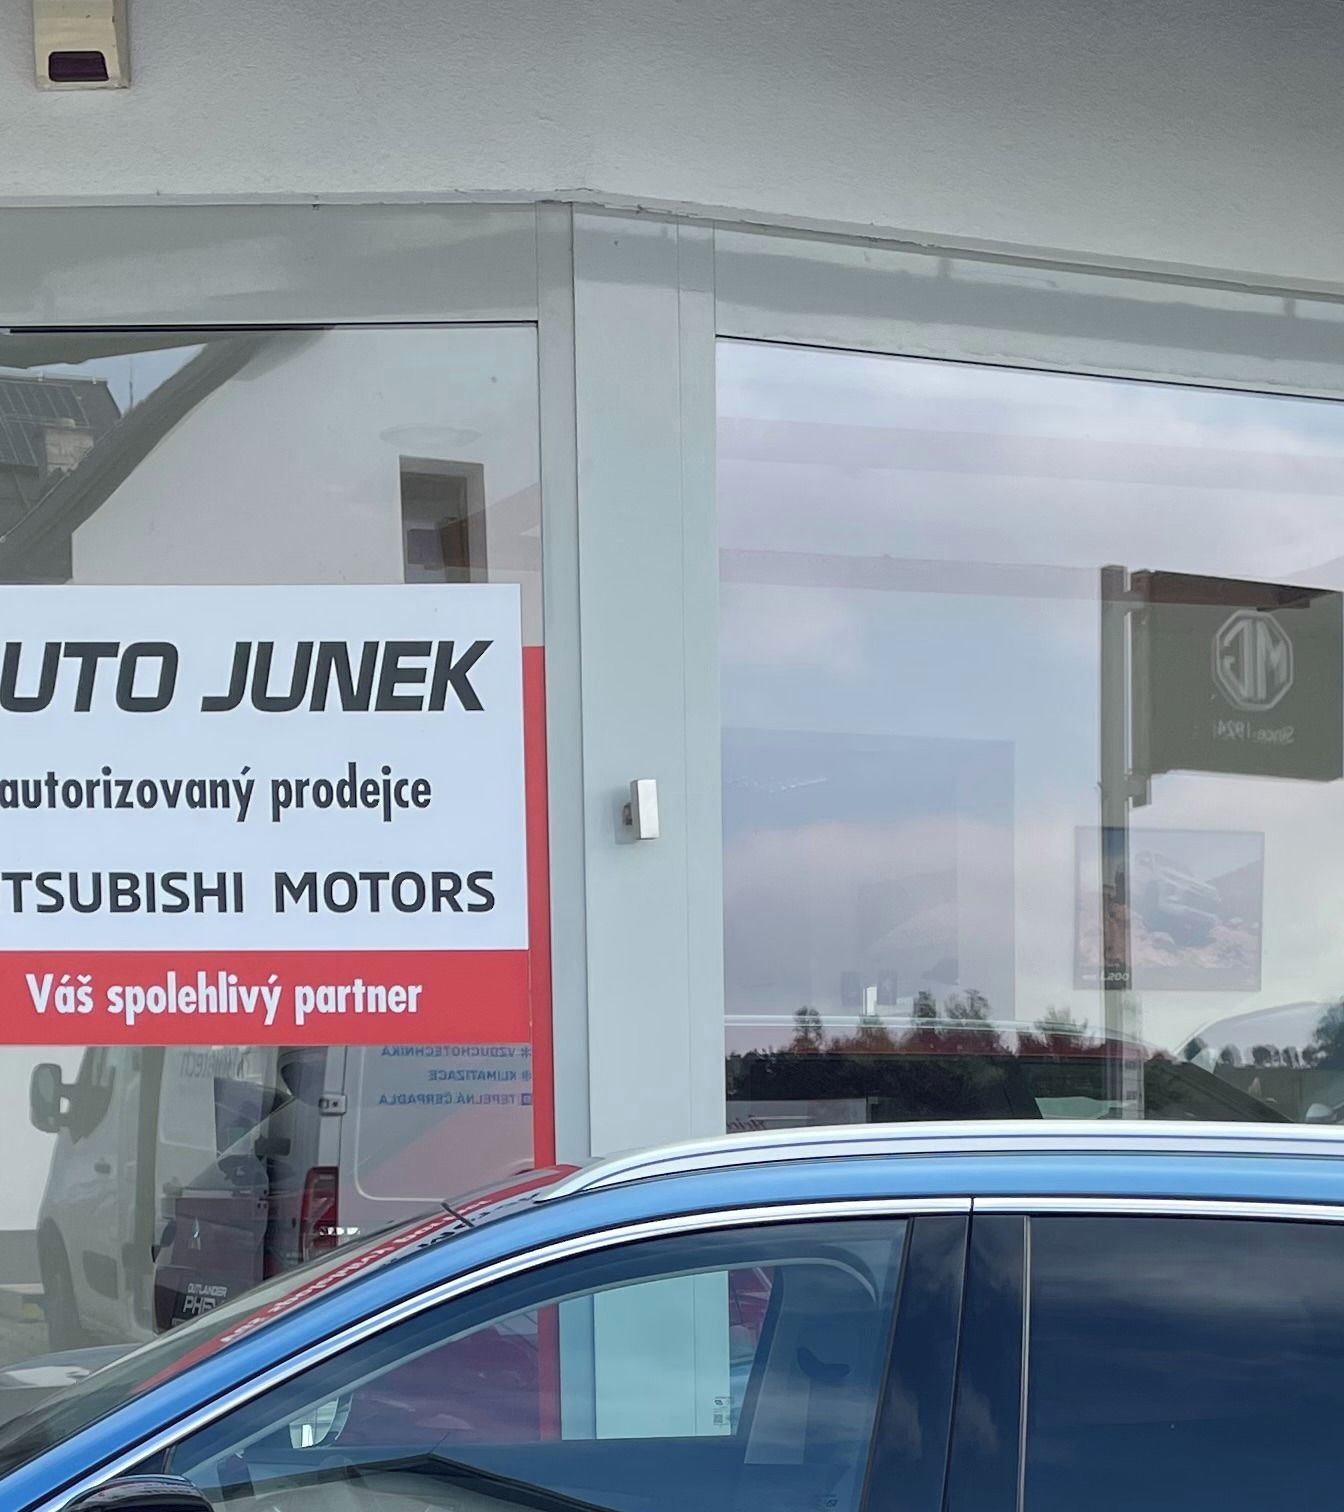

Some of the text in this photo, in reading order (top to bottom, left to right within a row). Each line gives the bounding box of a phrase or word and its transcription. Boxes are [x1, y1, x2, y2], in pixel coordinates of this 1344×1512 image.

[200, 639, 495, 713] JUNEK
[271, 761, 433, 823] prodejce
[274, 870, 496, 913] MOTORS
[25, 970, 424, 1027] Váš spolehlivý partner
